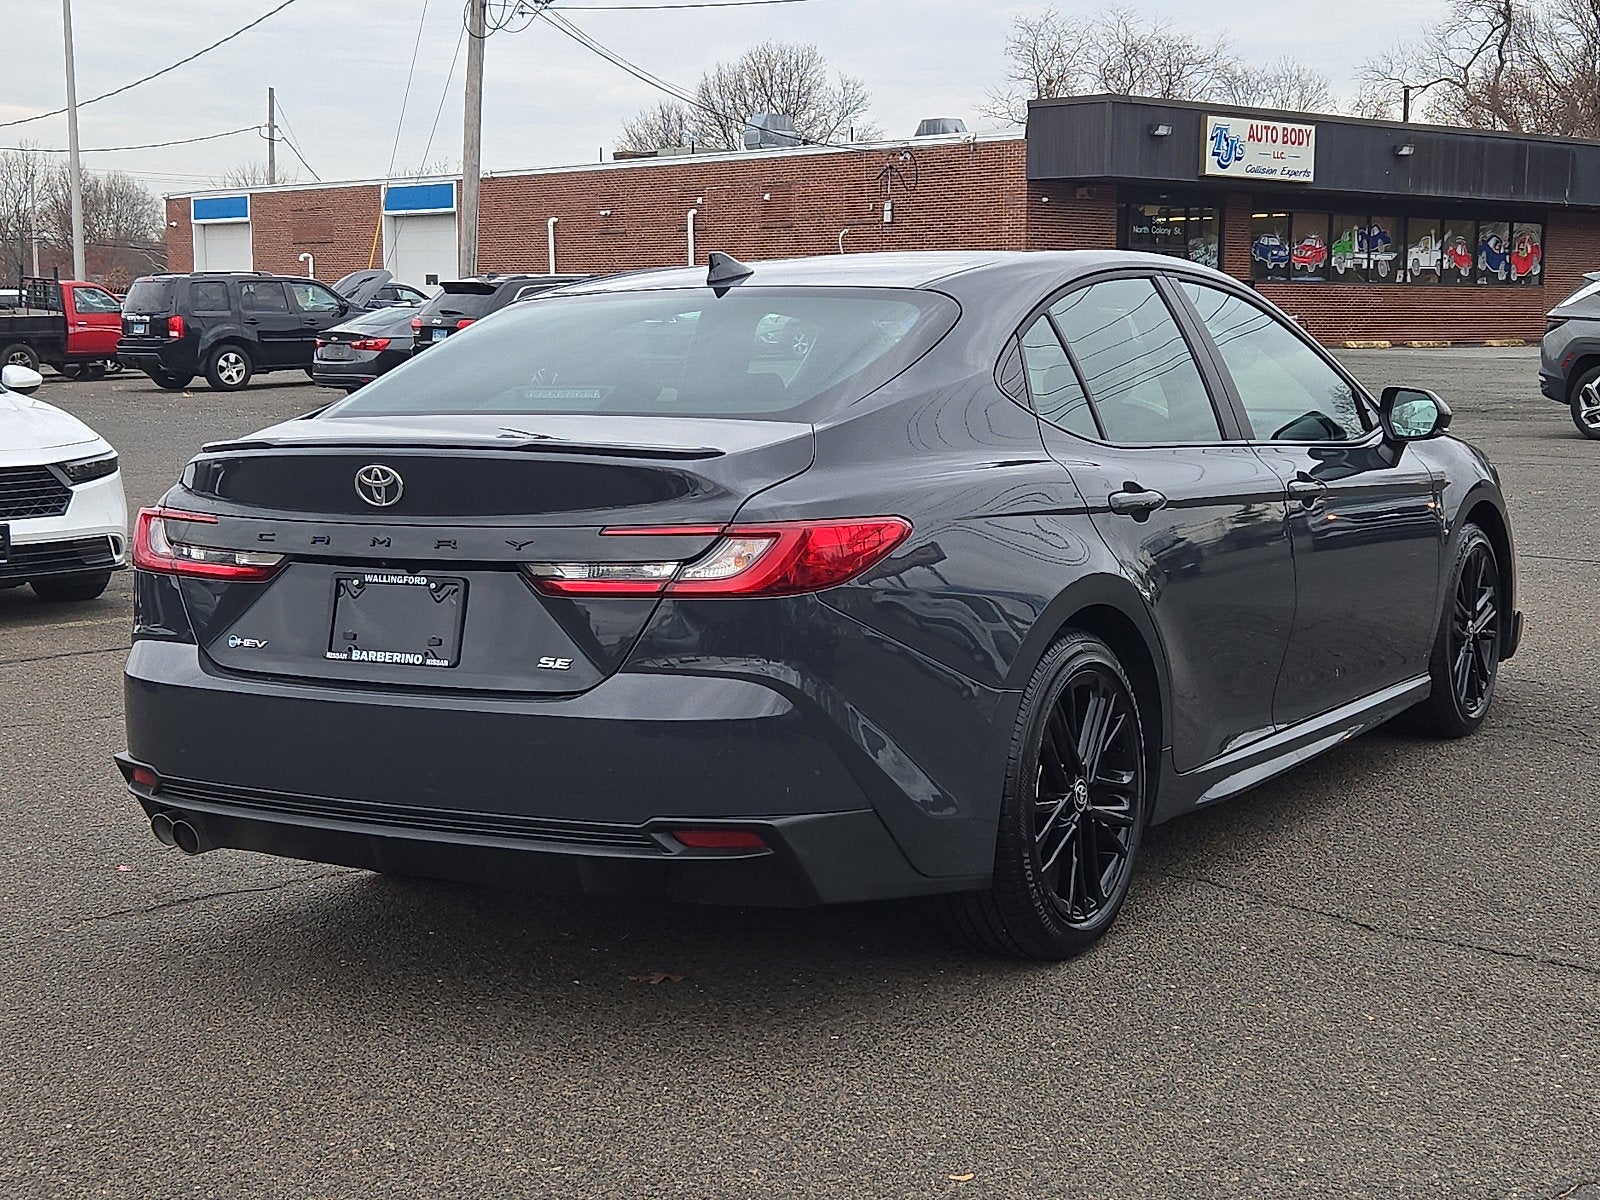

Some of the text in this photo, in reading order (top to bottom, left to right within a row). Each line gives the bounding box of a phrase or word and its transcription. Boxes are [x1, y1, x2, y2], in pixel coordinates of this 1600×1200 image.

[1247, 123, 1279, 144] AUTO
[1281, 126, 1313, 147] BODY
[1245, 164, 1312, 178] Collision Experts
[257, 531, 534, 551] CAMRY
[364, 574, 428, 585] WALLINGFORD
[351, 650, 423, 665] BARBERINO
[536, 656, 574, 670] SE
